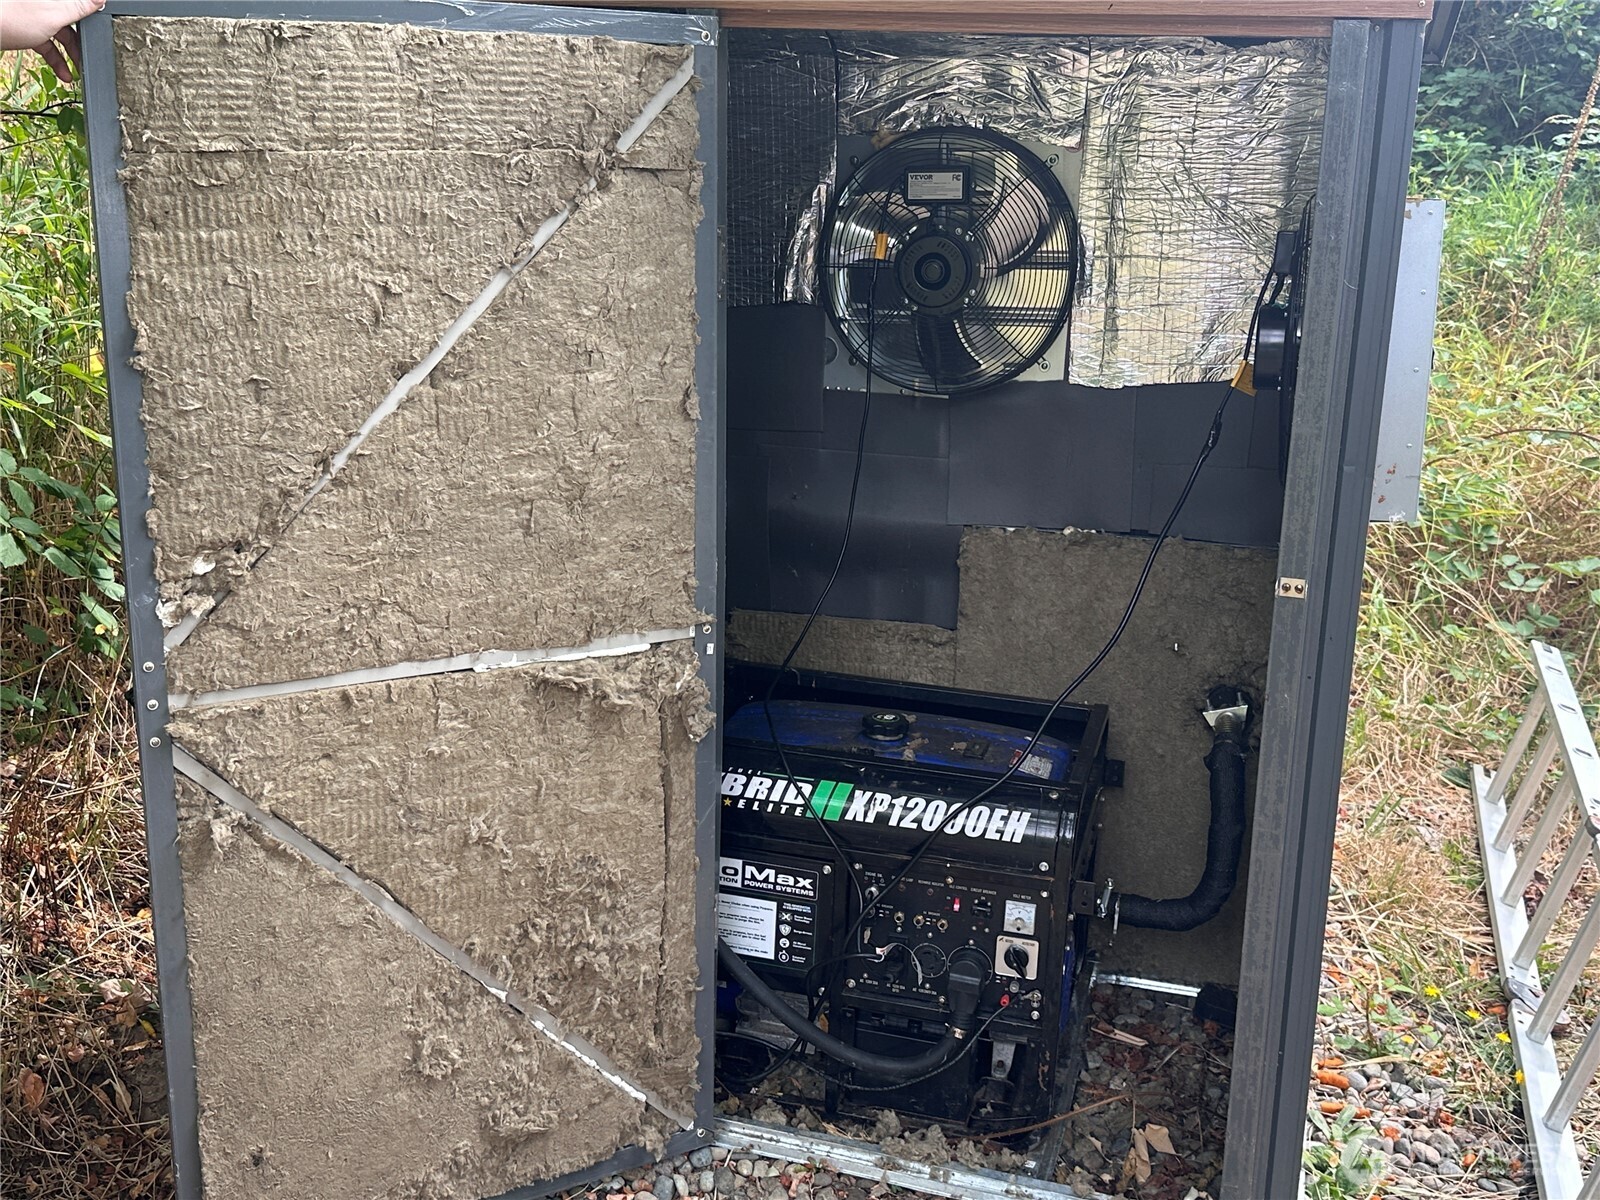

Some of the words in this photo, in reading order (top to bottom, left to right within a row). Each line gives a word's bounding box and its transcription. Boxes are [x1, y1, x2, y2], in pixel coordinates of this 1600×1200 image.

[728, 766, 763, 776] FUEL
[721, 771, 813, 805] BRID
[737, 799, 805, 817] ELITE
[844, 788, 1032, 844] XP12000EH
[744, 880, 774, 890] POWER
[775, 885, 814, 897] SYSTEMS
